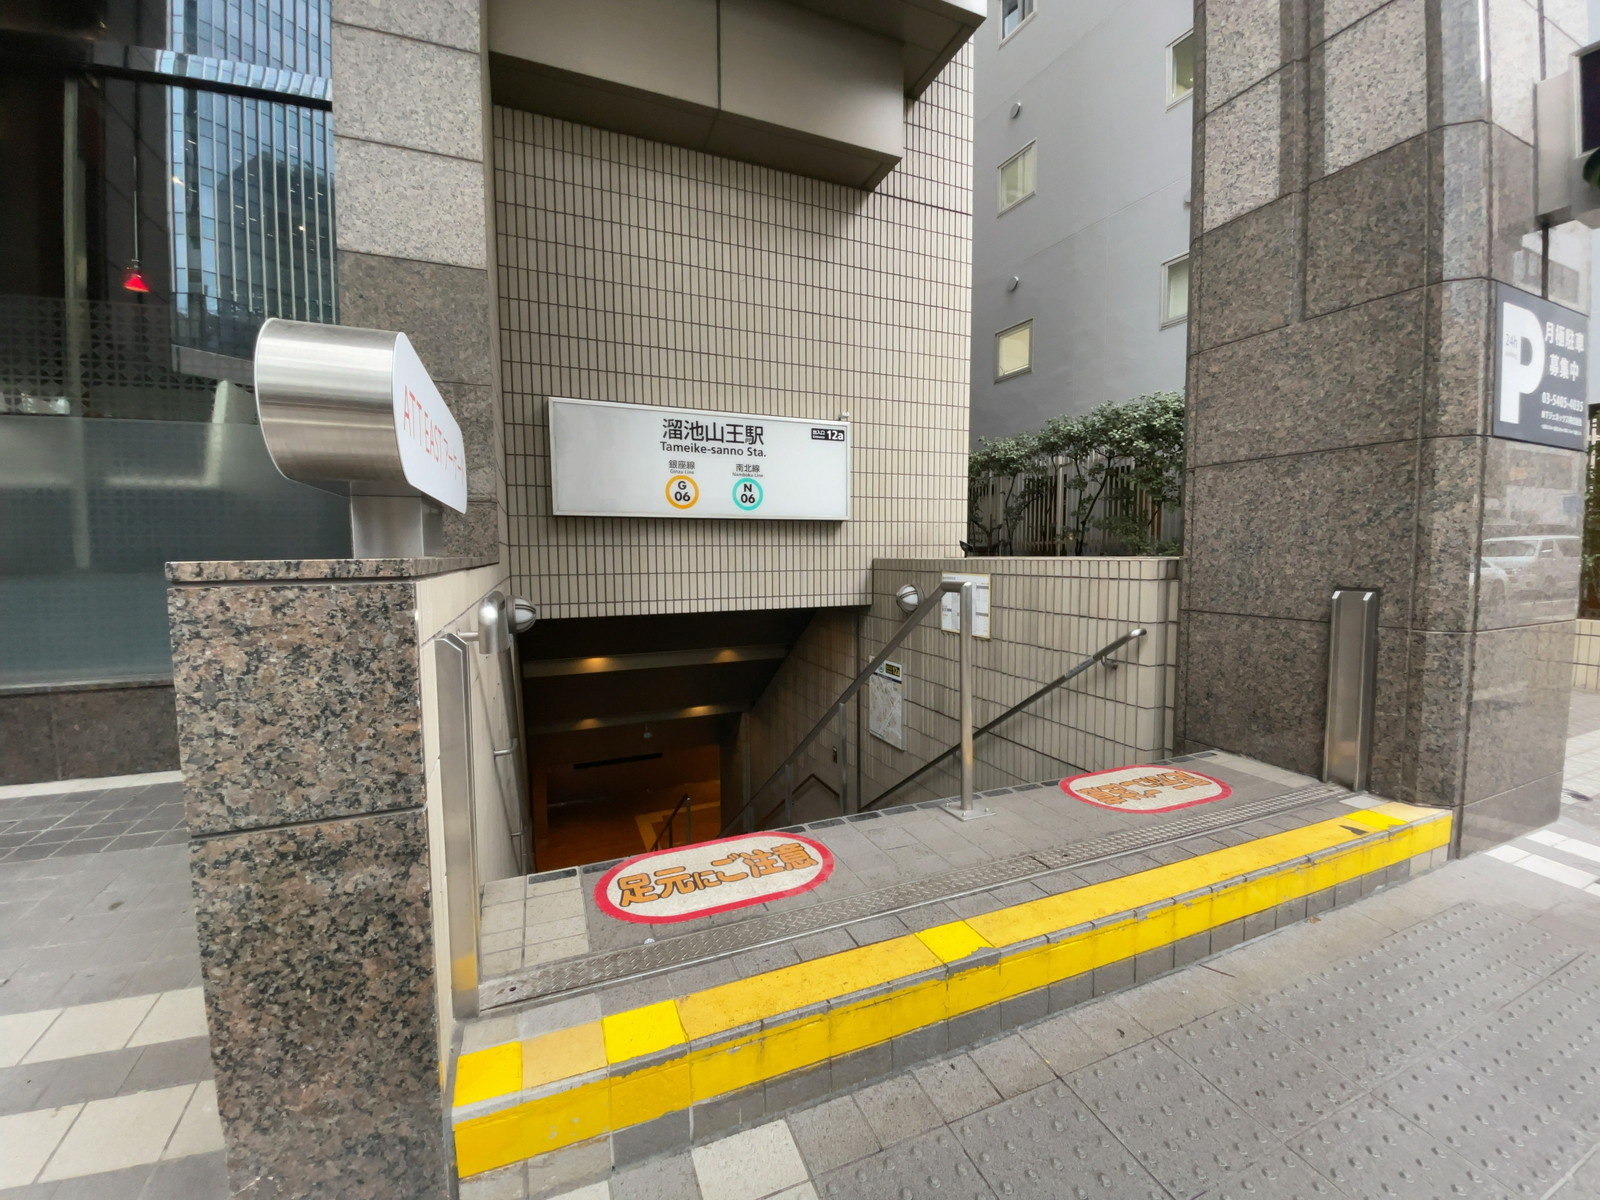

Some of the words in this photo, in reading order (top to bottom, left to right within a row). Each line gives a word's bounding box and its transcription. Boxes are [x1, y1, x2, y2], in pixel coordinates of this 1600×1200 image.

[1500, 302, 1545, 424] P
[1549, 354, 1579, 382] 募集中
[404, 385, 422, 446] ATT
[662, 418, 764, 446] 溜池山王駅
[827, 430, 844, 441] 12a
[660, 441, 744, 457] Tameike-sanno
[747, 447, 767, 458] Sta.
[668, 460, 695, 470] 銀座線
[736, 464, 760, 473] 南北線
[678, 481, 687, 491] G
[743, 483, 752, 493] N
[674, 491, 691, 502] 06
[740, 493, 755, 504] 06
[617, 842, 818, 907] 足元にご注意
